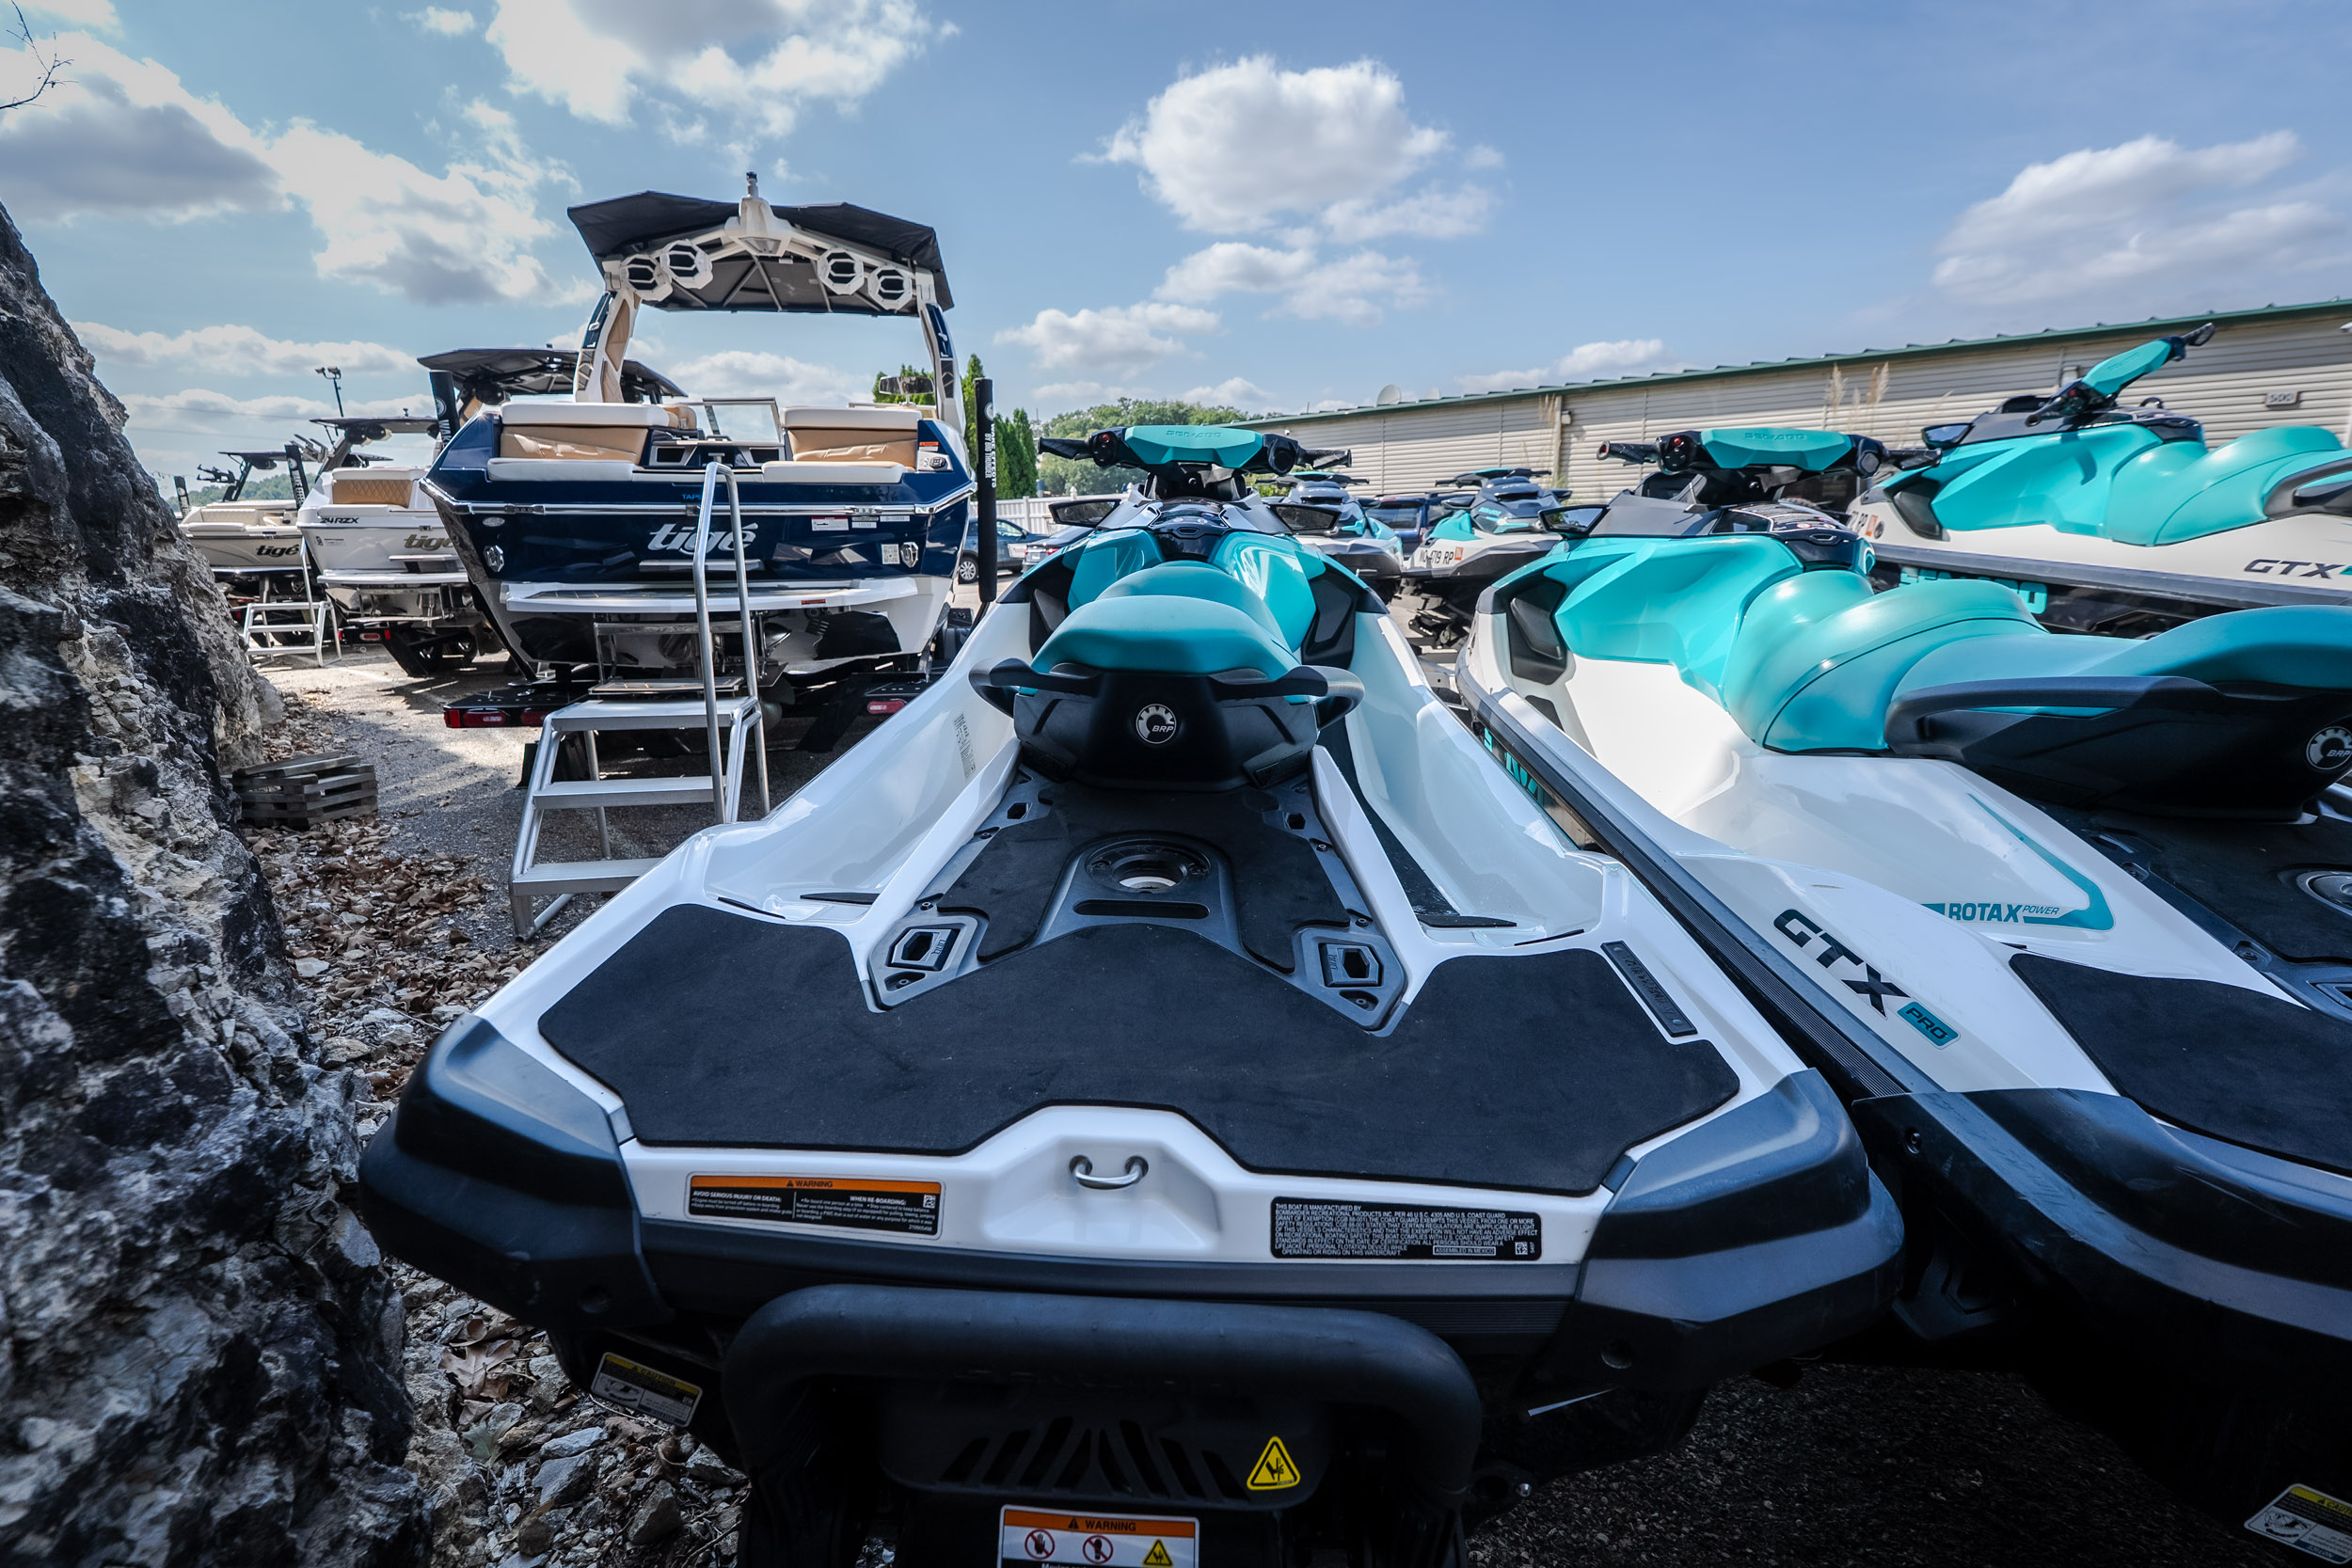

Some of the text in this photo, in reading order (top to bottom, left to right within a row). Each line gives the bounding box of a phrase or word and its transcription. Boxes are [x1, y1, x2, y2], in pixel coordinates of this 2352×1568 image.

[256, 543, 301, 558] tigé
[2244, 559, 2347, 579] GTX
[1152, 724, 1175, 734] BRP
[2326, 749, 2351, 758] BRP
[1948, 902, 2060, 924] ROTAX POWER
[1773, 909, 1949, 1040] GTX PRO
[796, 1180, 834, 1189] WARNING
[1085, 1519, 1137, 1531] WARNING
